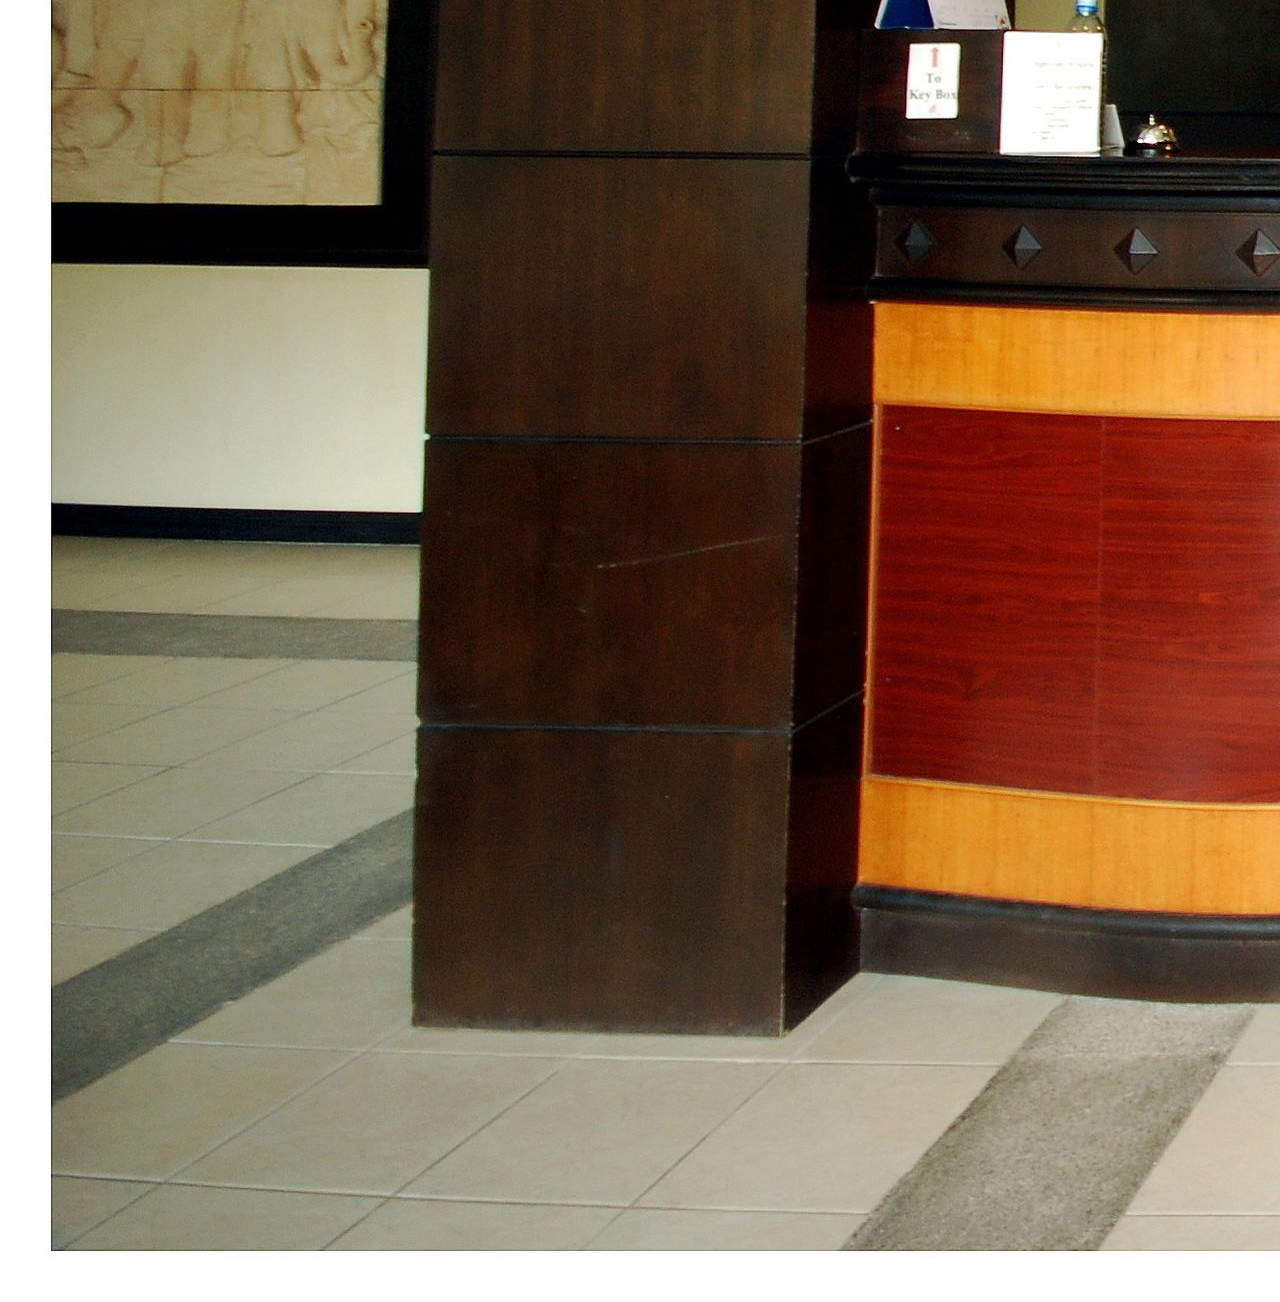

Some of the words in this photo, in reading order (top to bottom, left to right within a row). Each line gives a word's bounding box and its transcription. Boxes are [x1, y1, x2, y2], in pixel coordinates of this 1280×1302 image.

[926, 72, 942, 84] To
[909, 89, 931, 103] Key
[936, 89, 957, 100] Box
